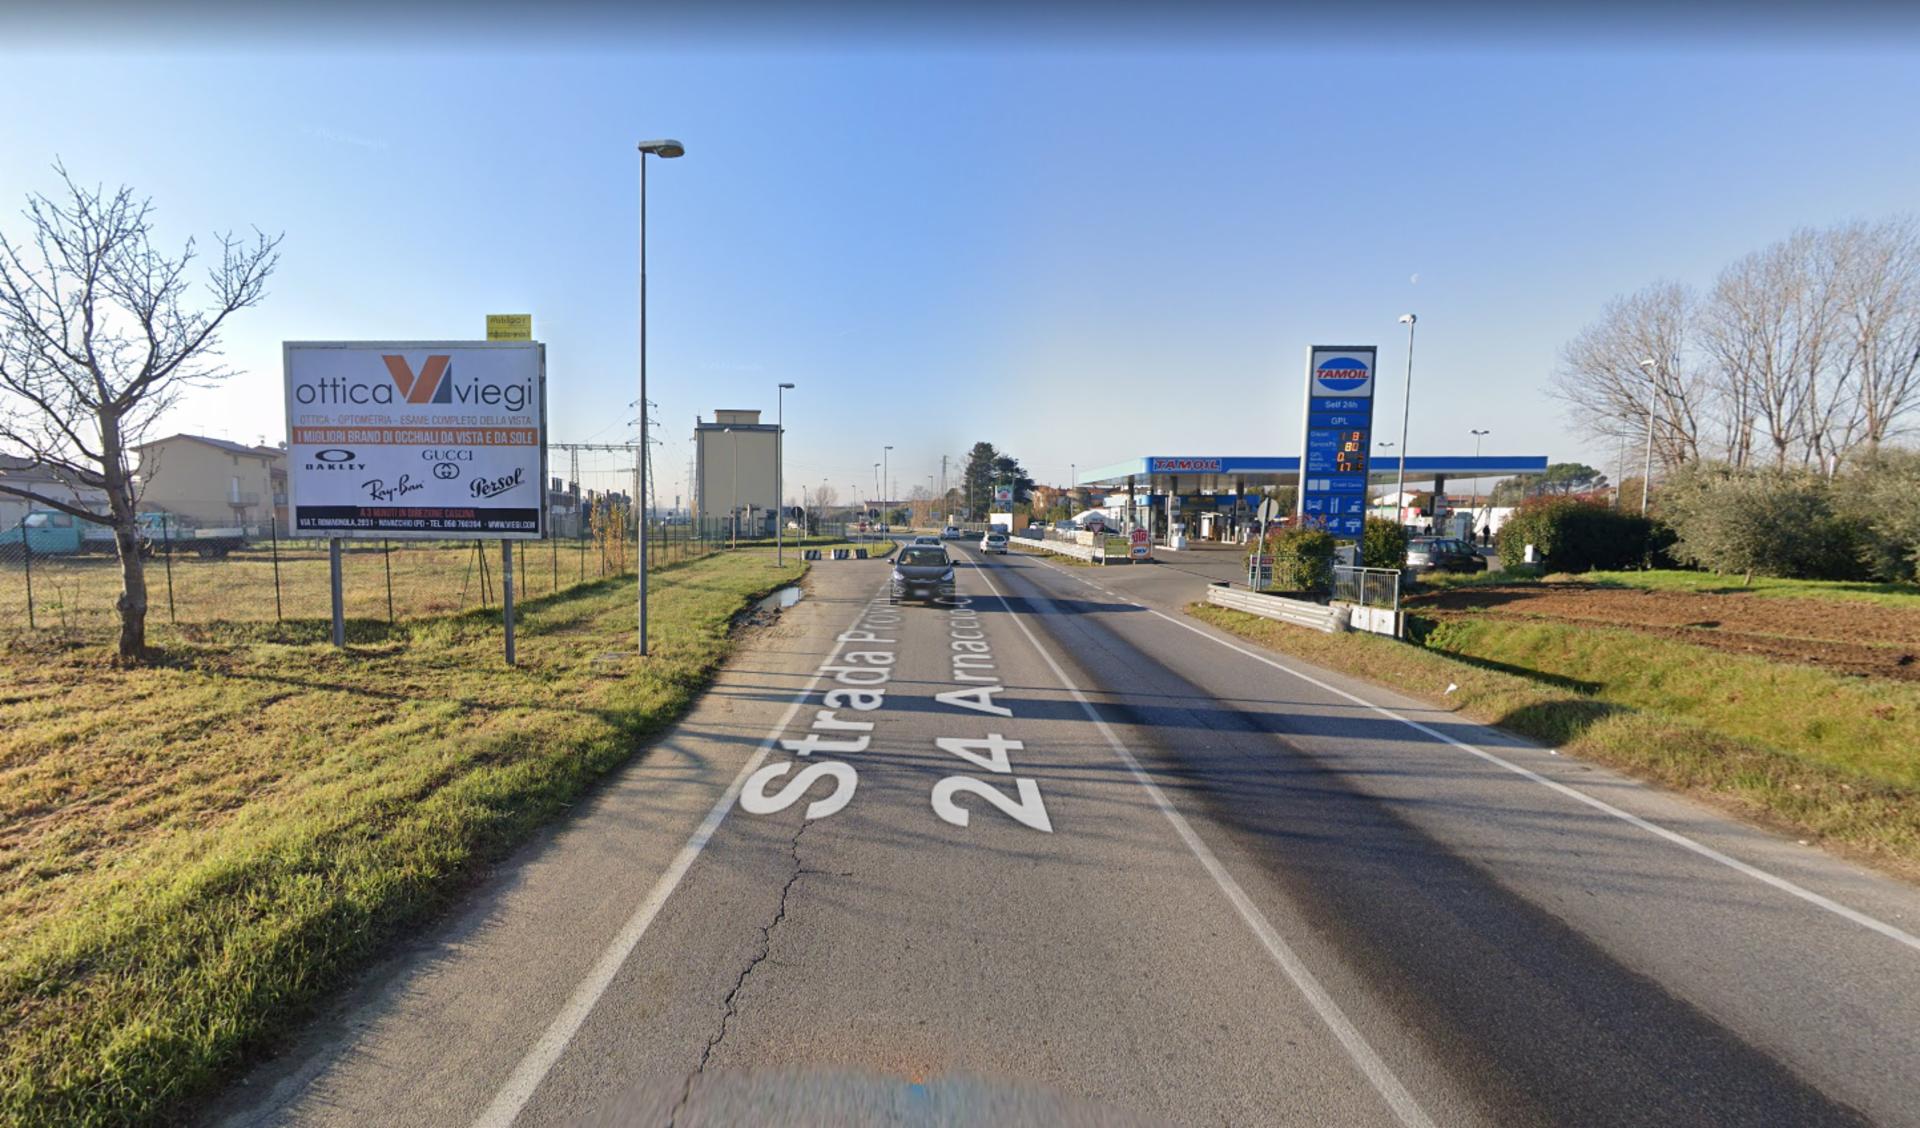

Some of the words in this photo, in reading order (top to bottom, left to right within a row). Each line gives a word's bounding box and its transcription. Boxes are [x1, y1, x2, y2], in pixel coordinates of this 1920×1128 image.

[1315, 368, 1370, 379] TAMOIL
[296, 377, 393, 405] ottica
[454, 377, 532, 412] viegi
[1325, 400, 1341, 409] Self
[1342, 400, 1359, 409] 24h
[301, 414, 329, 425] OTTICA
[338, 414, 392, 425] OPTOMETRIA
[401, 415, 429, 425] ESAME
[432, 415, 478, 425] COMPLETO
[480, 415, 507, 425] DELLA
[508, 415, 533, 425] VISTA
[1330, 416, 1349, 425] GPL
[304, 430, 346, 443] MIGLIORI
[348, 430, 381, 443] BRAND
[383, 430, 393, 443] DI
[395, 430, 439, 444] OCCHIALI
[441, 431, 453, 444] DA
[456, 431, 483, 444] VISTA
[486, 431, 492, 444] E
[495, 431, 508, 444] DA
[511, 431, 533, 444] SOLE
[422, 449, 473, 461] GUCCI
[305, 463, 366, 471] OAKLEY
[1154, 459, 1221, 470] TAMOIL
[361, 474, 425, 501] Ray-Ban
[469, 467, 524, 498] Persol
[300, 518, 310, 527] VIA
